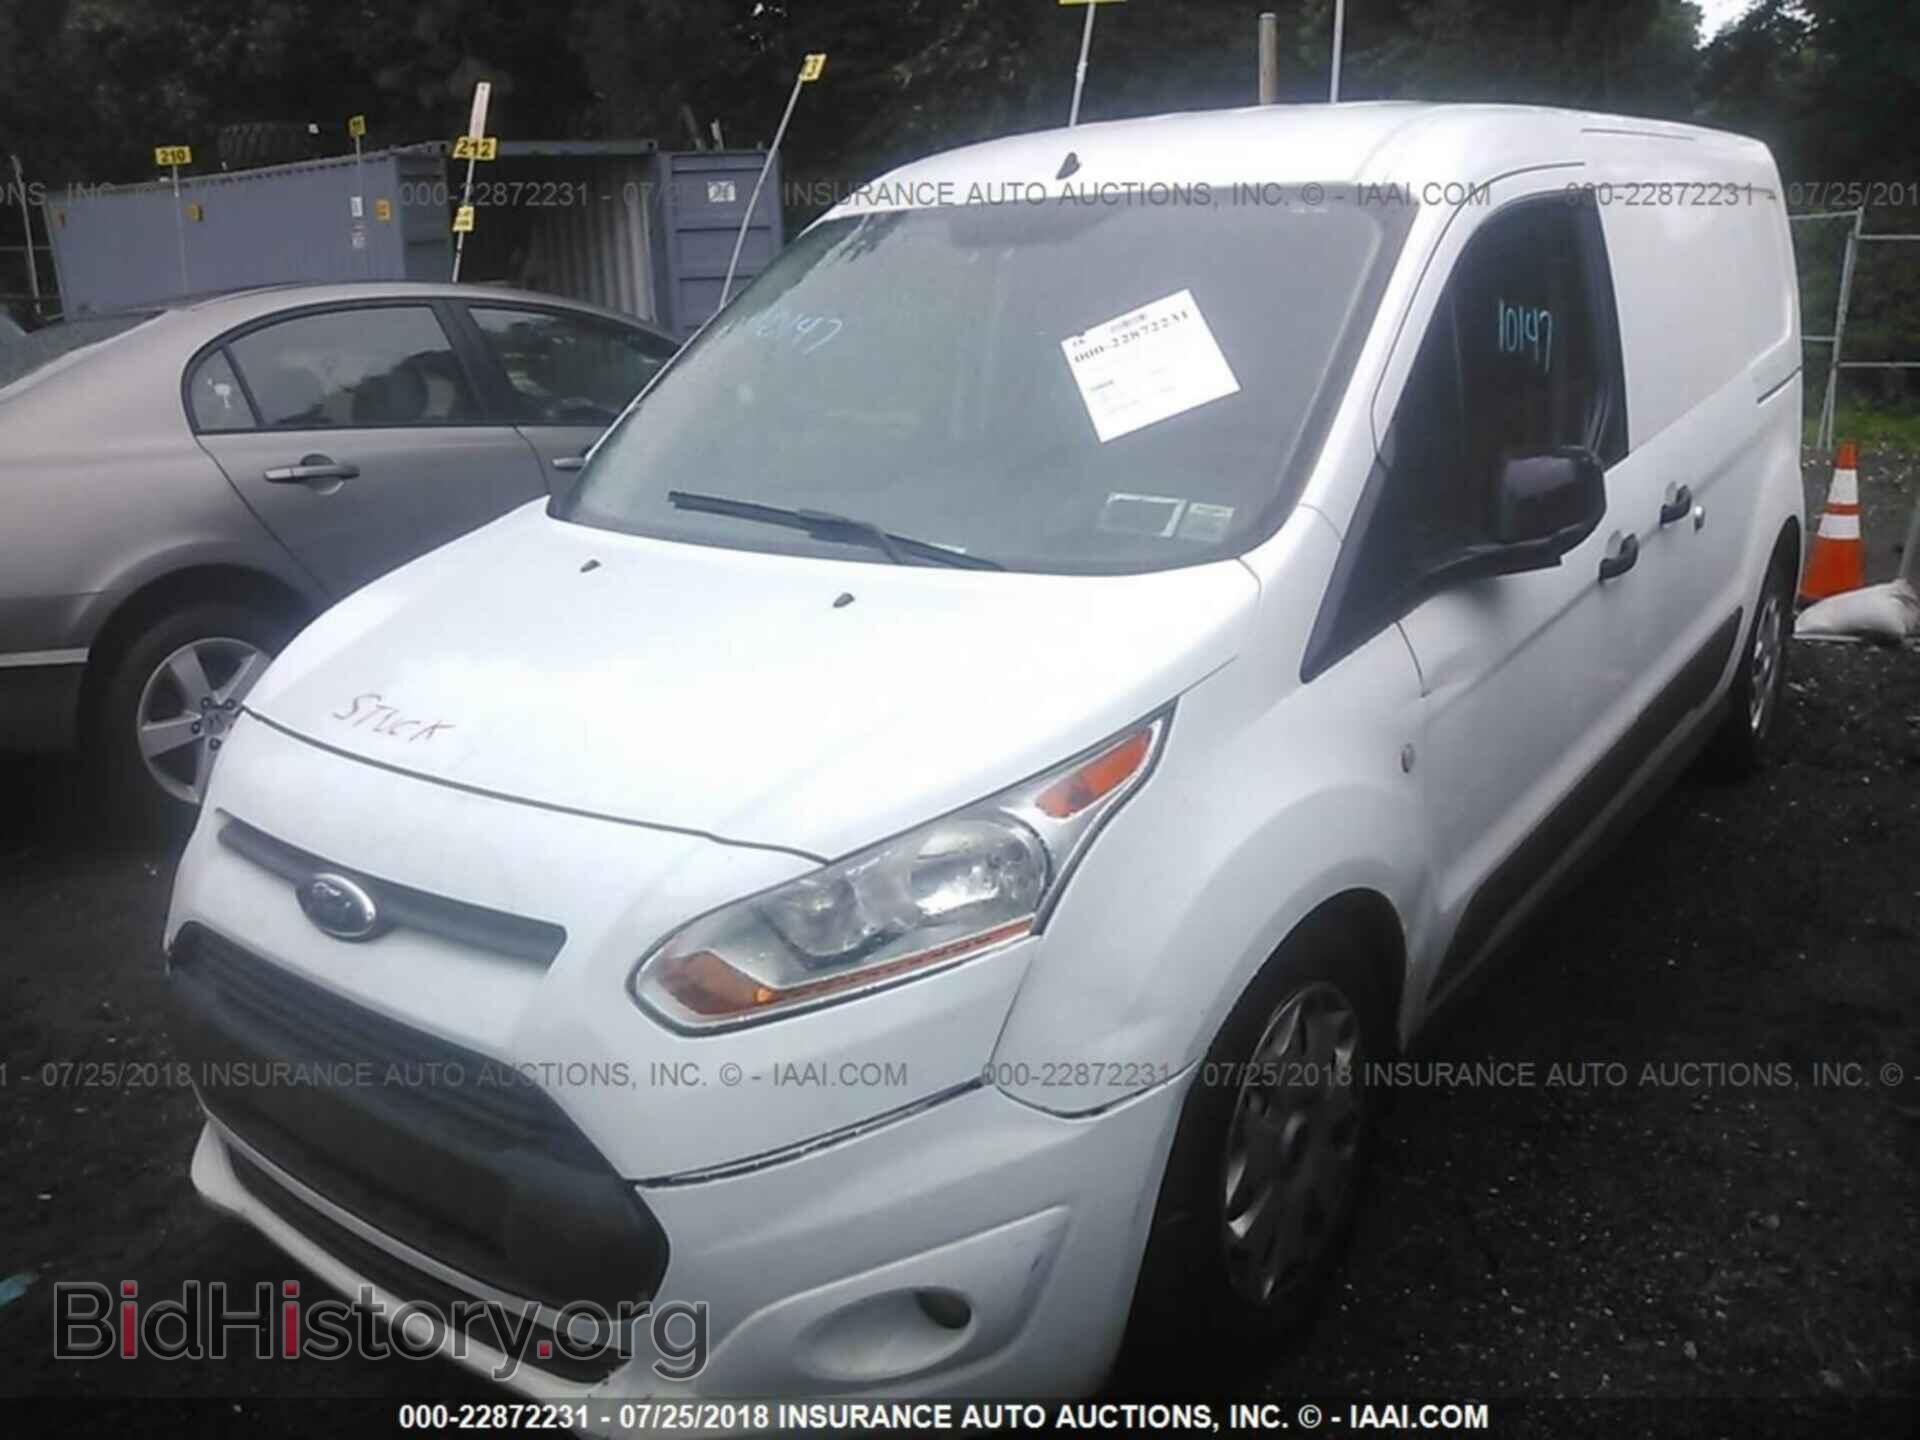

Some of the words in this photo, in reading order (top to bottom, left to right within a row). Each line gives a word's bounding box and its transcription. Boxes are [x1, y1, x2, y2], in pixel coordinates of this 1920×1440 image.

[159, 148, 186, 162] 210
[457, 139, 491, 157] 212
[1497, 296, 1553, 375] 10147
[330, 692, 457, 744] STUCK
